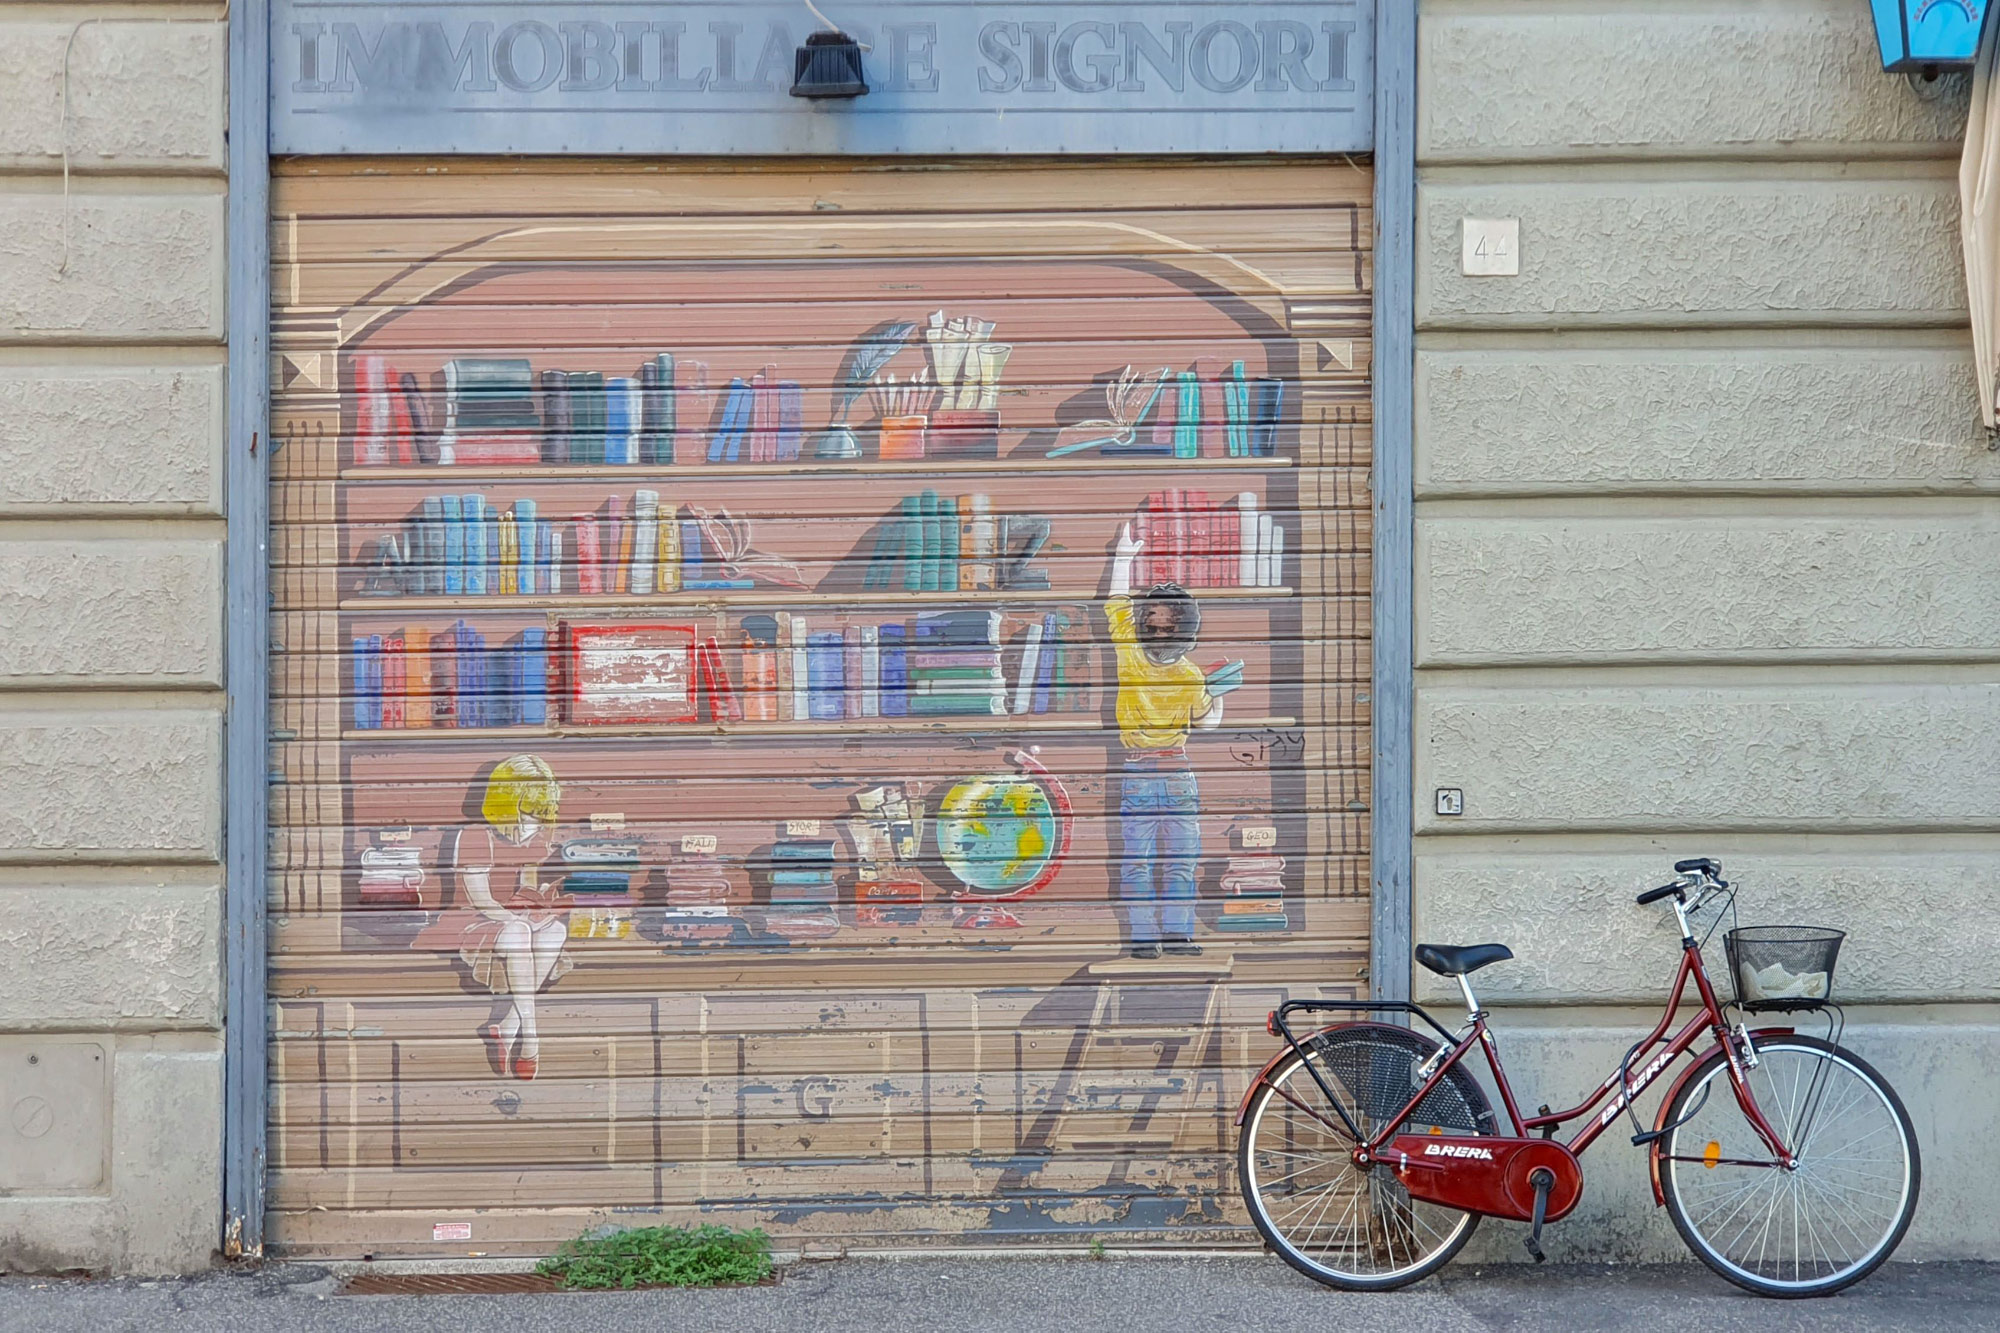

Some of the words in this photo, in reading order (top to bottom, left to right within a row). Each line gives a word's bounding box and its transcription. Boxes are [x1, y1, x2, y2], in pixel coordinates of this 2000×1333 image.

[978, 19, 1356, 94] SIGNORI
[1473, 234, 1508, 260] 44
[1601, 1052, 1675, 1126] BRERA
[1424, 1144, 1493, 1160] BRERA
